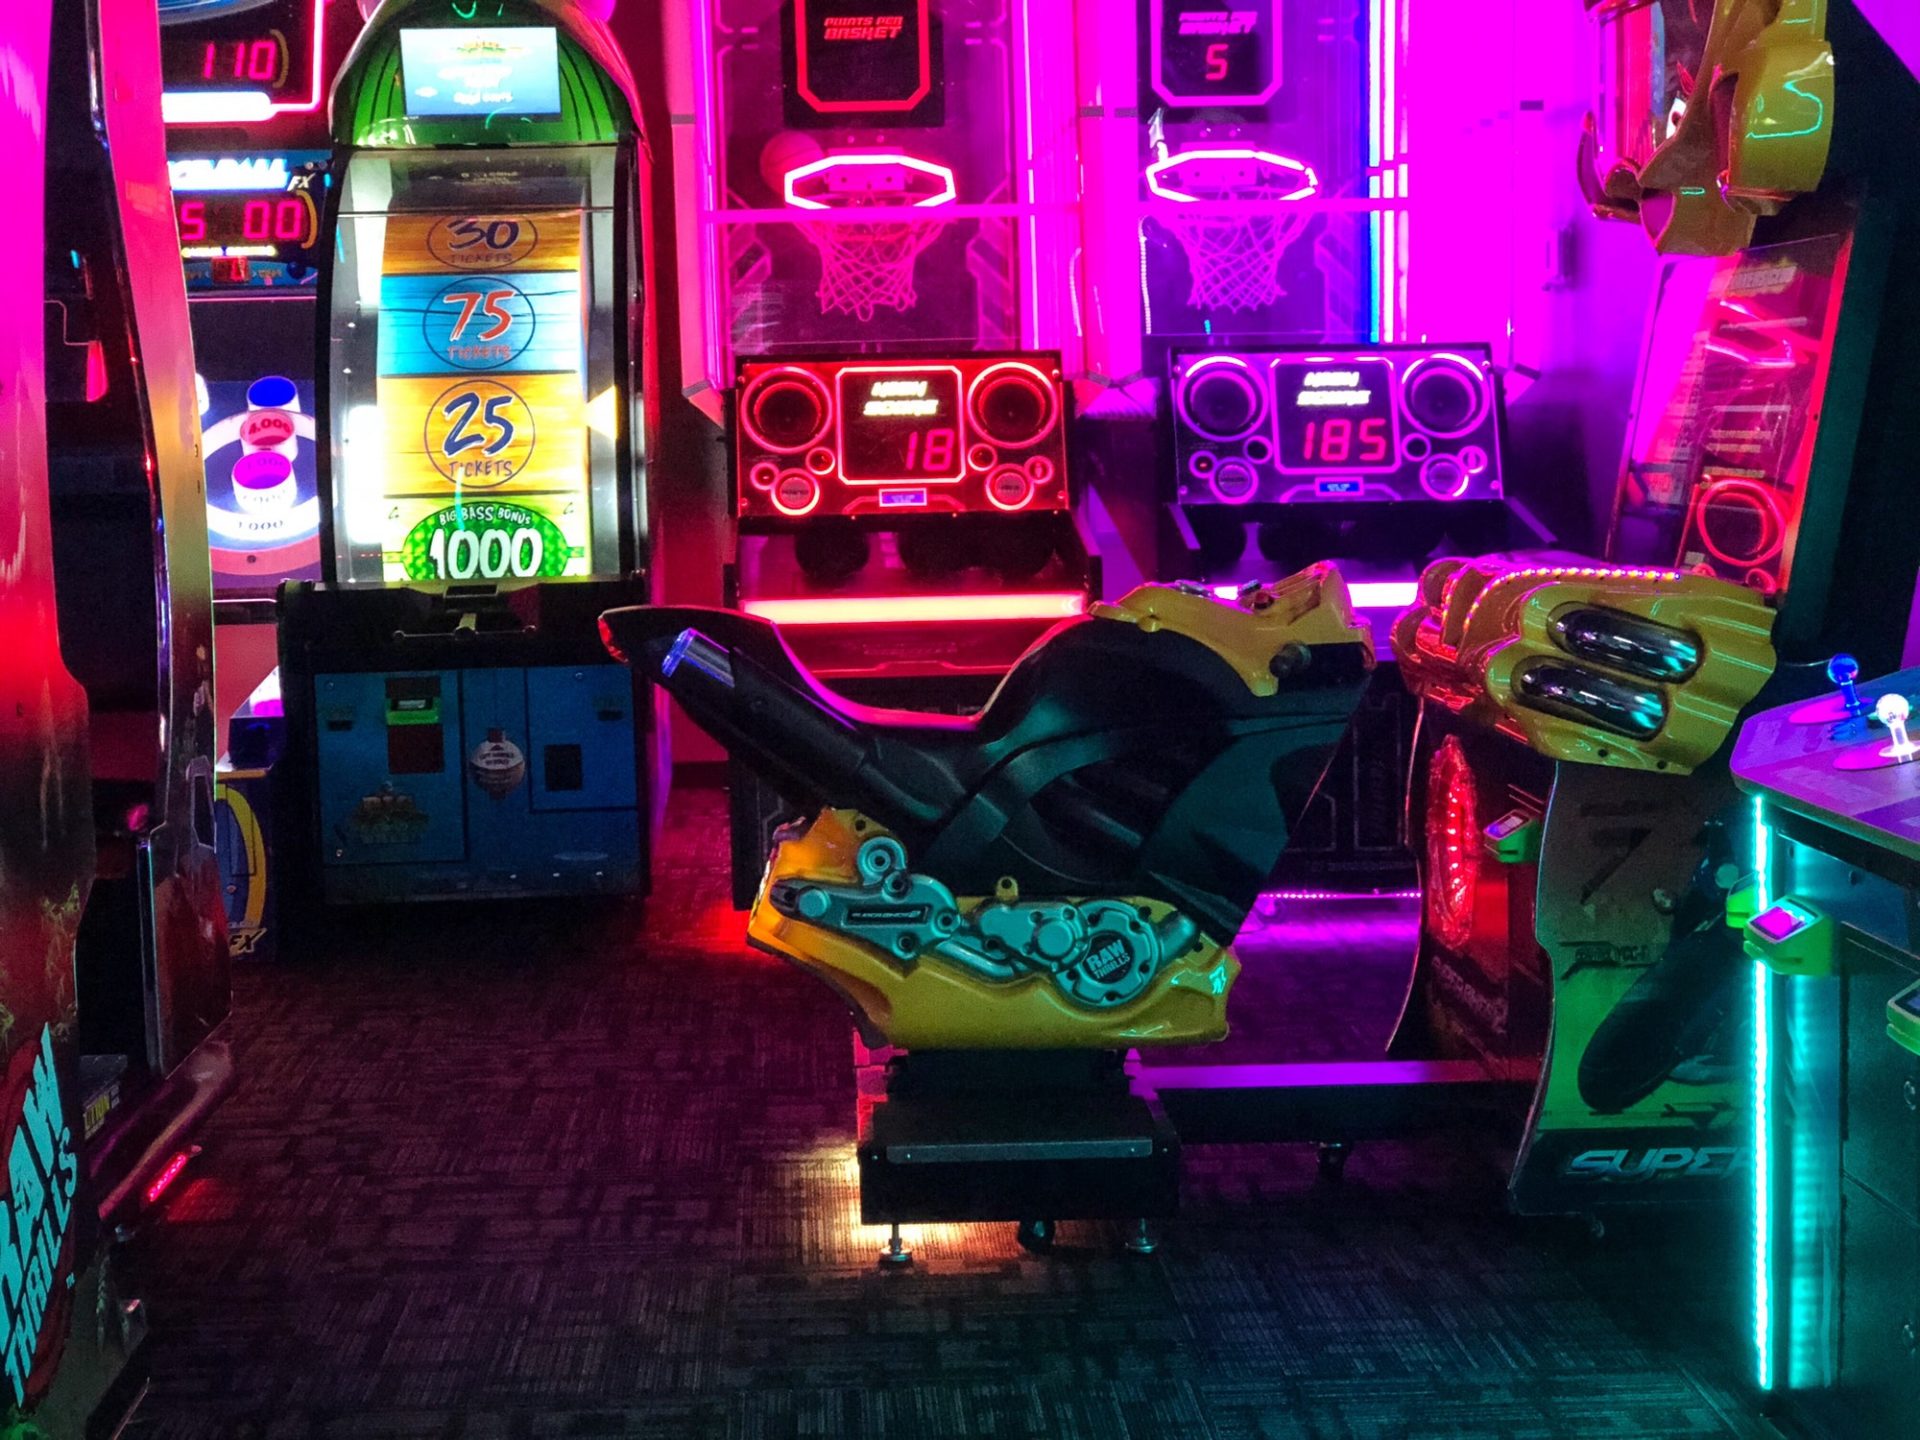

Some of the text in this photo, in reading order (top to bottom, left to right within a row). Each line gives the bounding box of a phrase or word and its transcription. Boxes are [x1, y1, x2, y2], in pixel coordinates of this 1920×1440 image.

[1205, 43, 1229, 81] 5
[287, 172, 316, 191] FX
[446, 219, 520, 250] 30
[450, 252, 513, 264] TICKETS
[443, 290, 516, 341] 75
[448, 345, 512, 361] TICKETS
[442, 392, 515, 458] 25
[1303, 418, 1387, 461] 185
[905, 428, 955, 471] 18
[439, 506, 532, 526] BIG BASS BONUS
[429, 527, 543, 580] 1000
[1086, 939, 1126, 972] RAW
[1093, 952, 1131, 979] THRILLS
[4, 1126, 78, 1409] THRILLS
